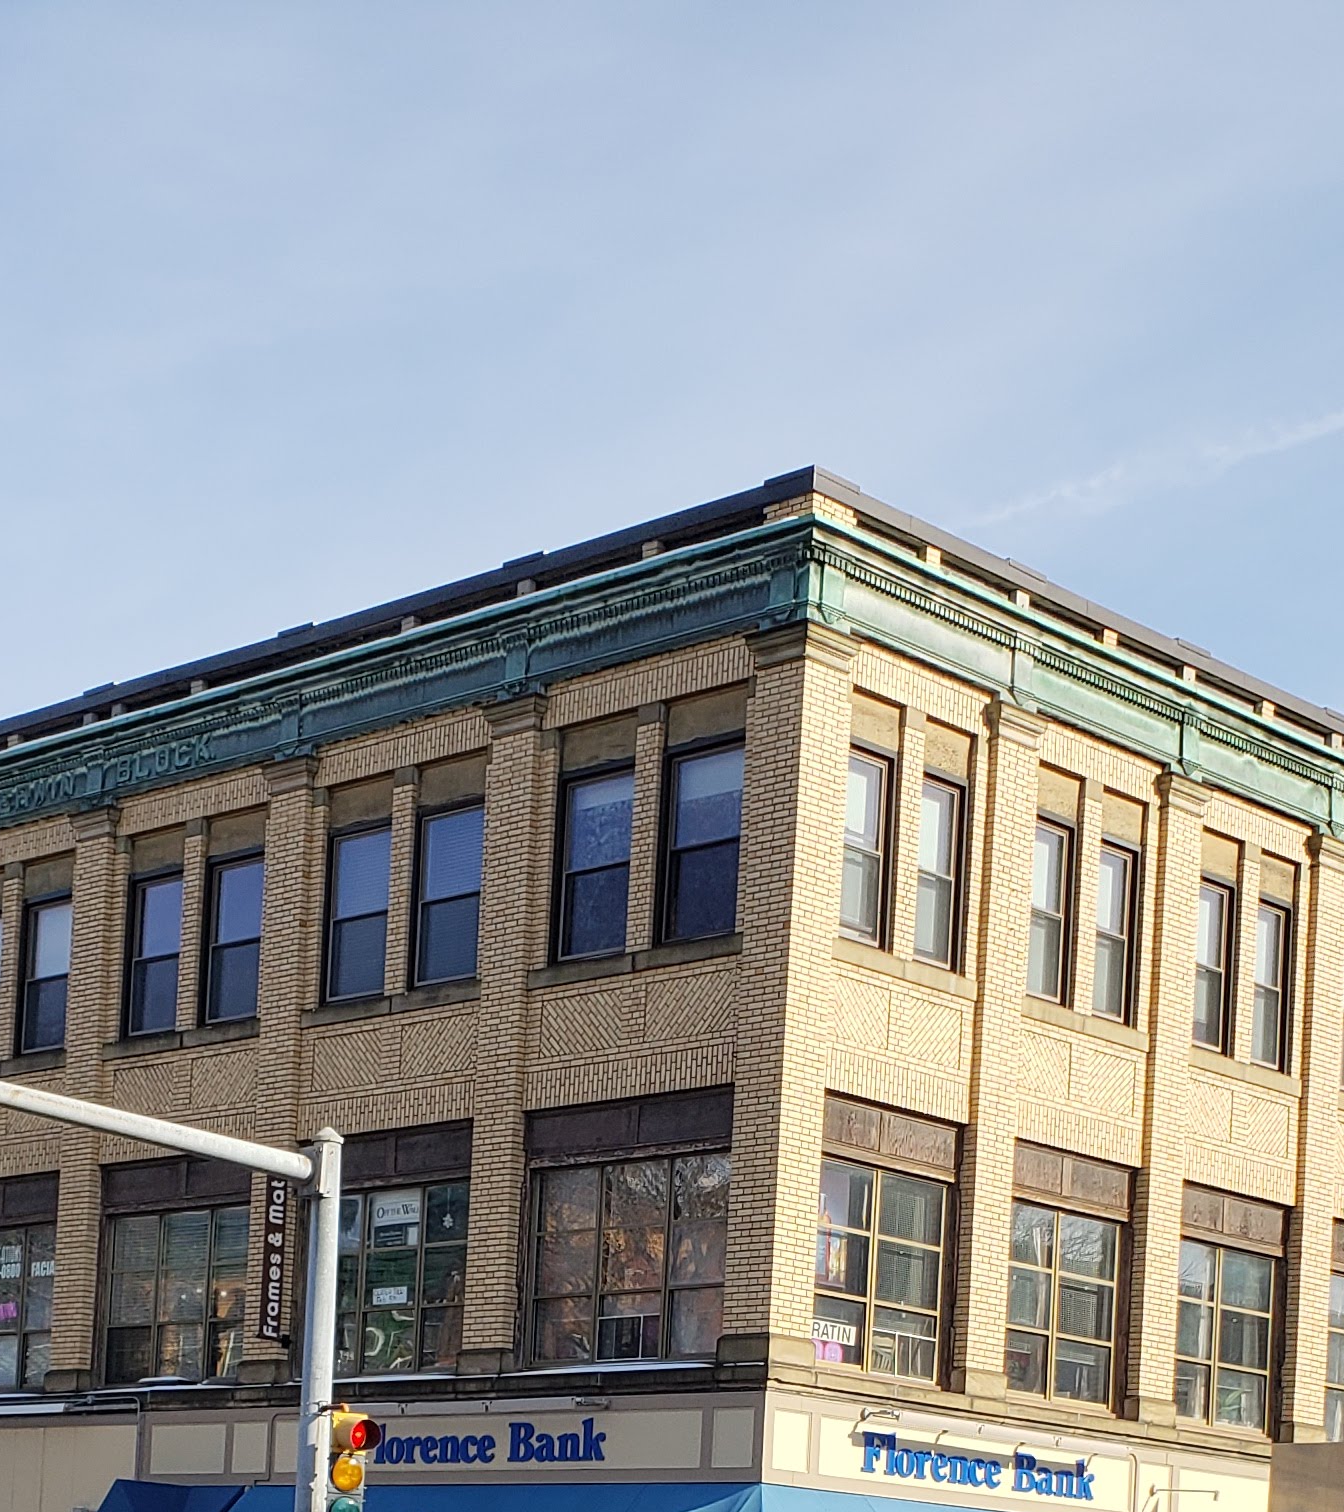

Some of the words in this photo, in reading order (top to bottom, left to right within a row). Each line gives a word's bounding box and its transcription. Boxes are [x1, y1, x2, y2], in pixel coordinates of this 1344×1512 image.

[267, 1231, 283, 1247] &
[263, 1253, 282, 1338] Frames
[507, 1418, 606, 1463] Bank
[861, 1430, 1002, 1489] Florence
[1011, 1451, 1096, 1501] Bank
